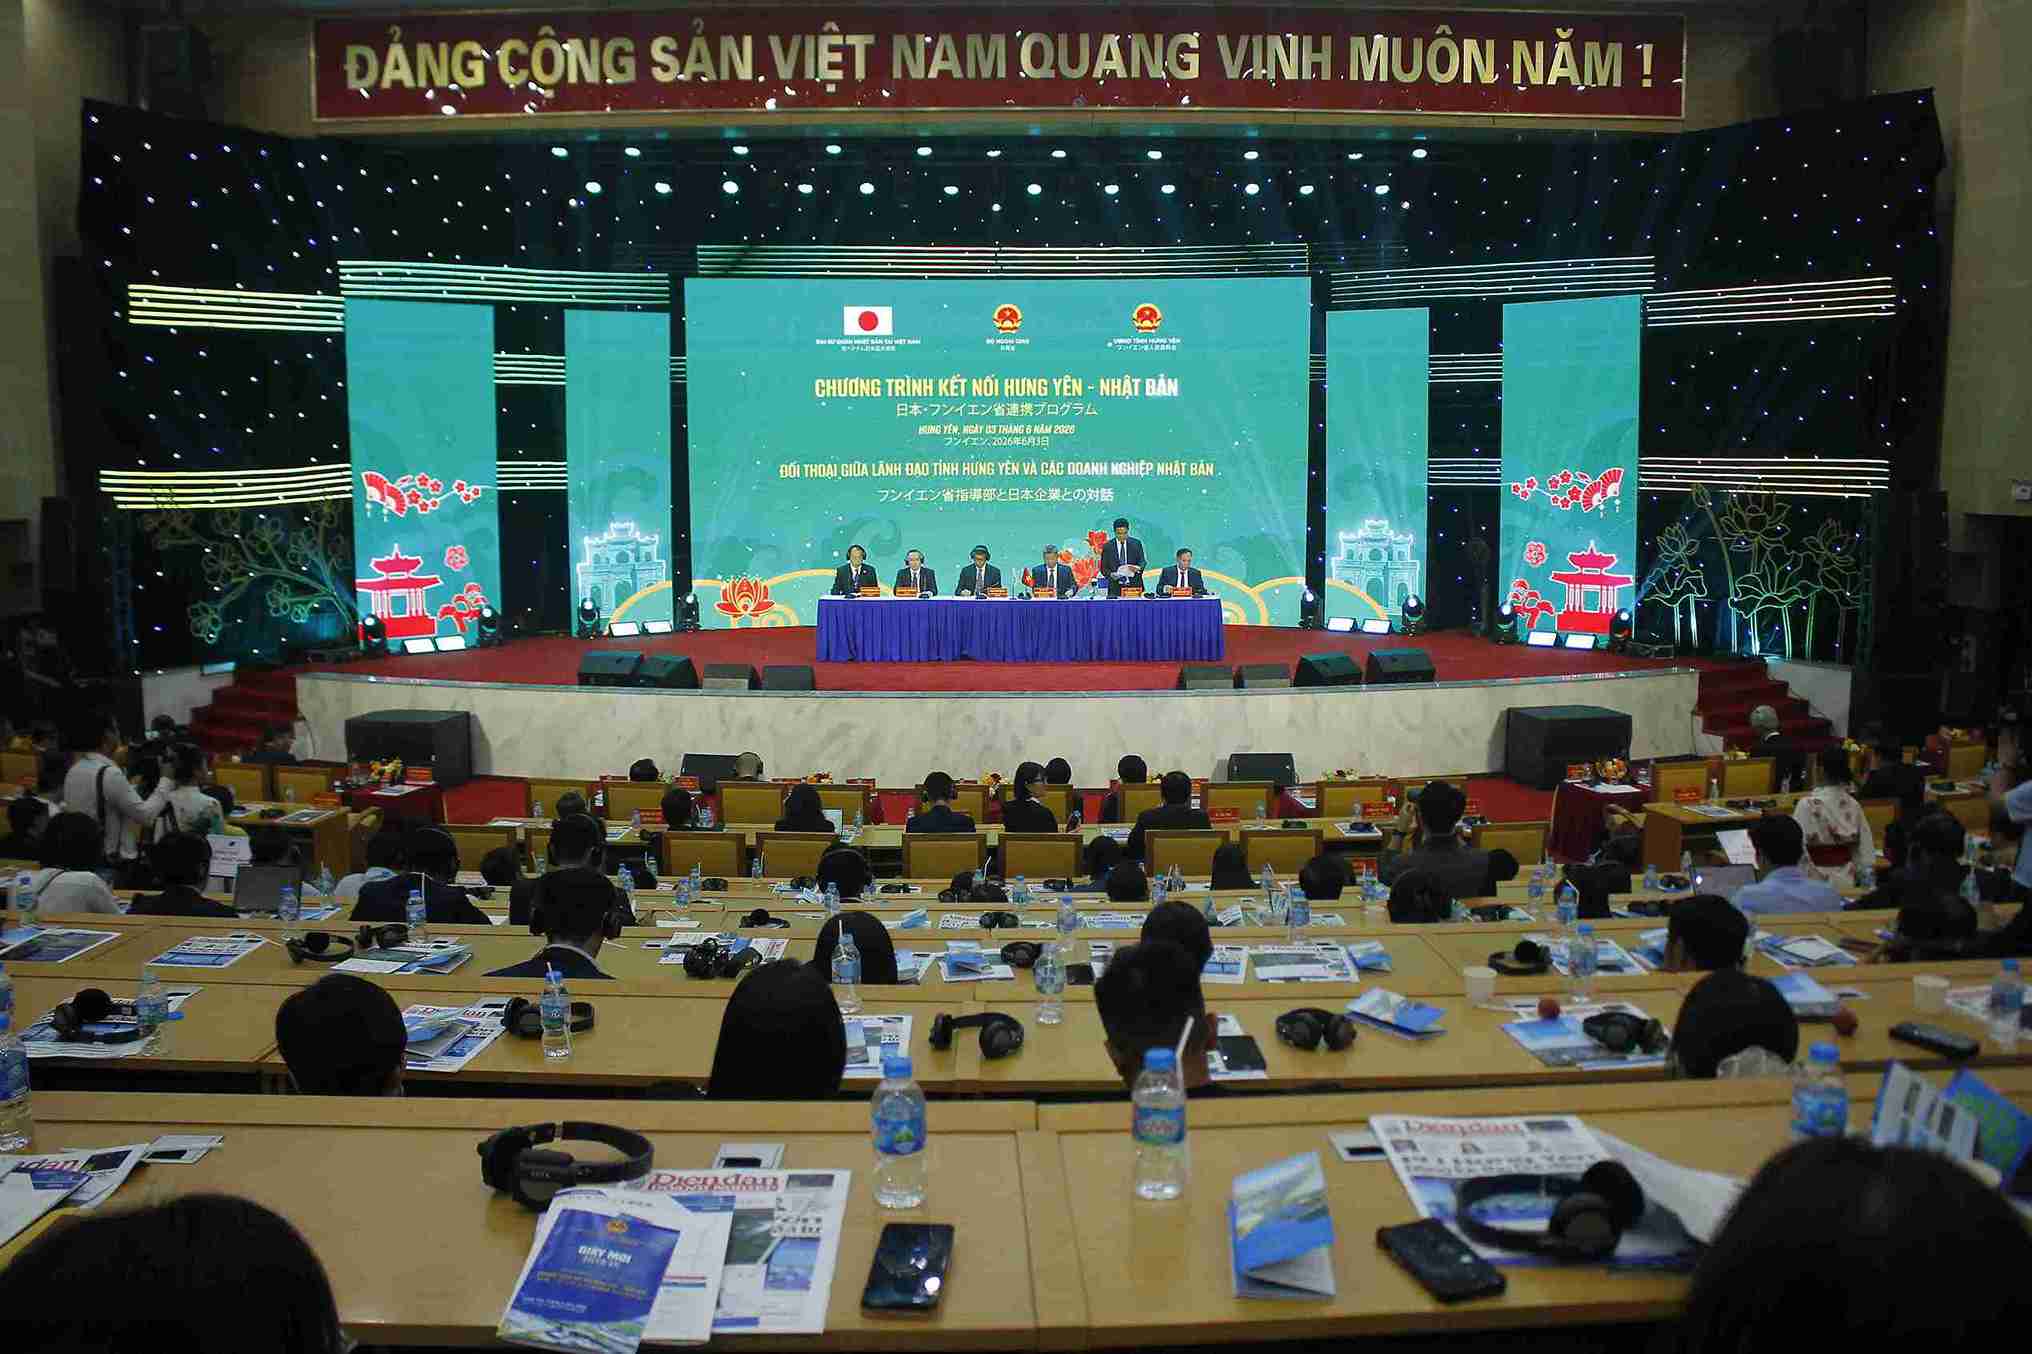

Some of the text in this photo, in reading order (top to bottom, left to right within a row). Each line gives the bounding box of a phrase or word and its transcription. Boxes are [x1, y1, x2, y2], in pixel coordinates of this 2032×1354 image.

[344, 17, 1654, 98] ĐẢNG CỘNG SẢN VIỆT NAM QUANG VINH MUÔN NĂM !
[815, 376, 881, 397] CHƯƠNG
[886, 374, 934, 397] TRÌNH
[938, 374, 967, 397] KẾT
[972, 374, 999, 397] NỐI
[1004, 377, 1048, 397] HƯNG
[1053, 374, 1083, 397] YÊN
[1100, 374, 1141, 399] NHẬT
[1145, 373, 1179, 397] BẢN
[779, 461, 800, 479] ĐỐI
[804, 463, 837, 480] THOẠI
[841, 460, 869, 477] GIỮA
[905, 462, 929, 478] ĐẠO
[962, 461, 994, 475] HƯNG
[998, 459, 1020, 476] YÊN
[1023, 458, 1038, 476] VÀ
[1041, 459, 1064, 475] CÁC
[1068, 462, 1107, 476] DOANH
[1111, 460, 1153, 478] NGHIỆP
[1157, 460, 1186, 477] NHẬT
[1190, 459, 1214, 476] BẢN
